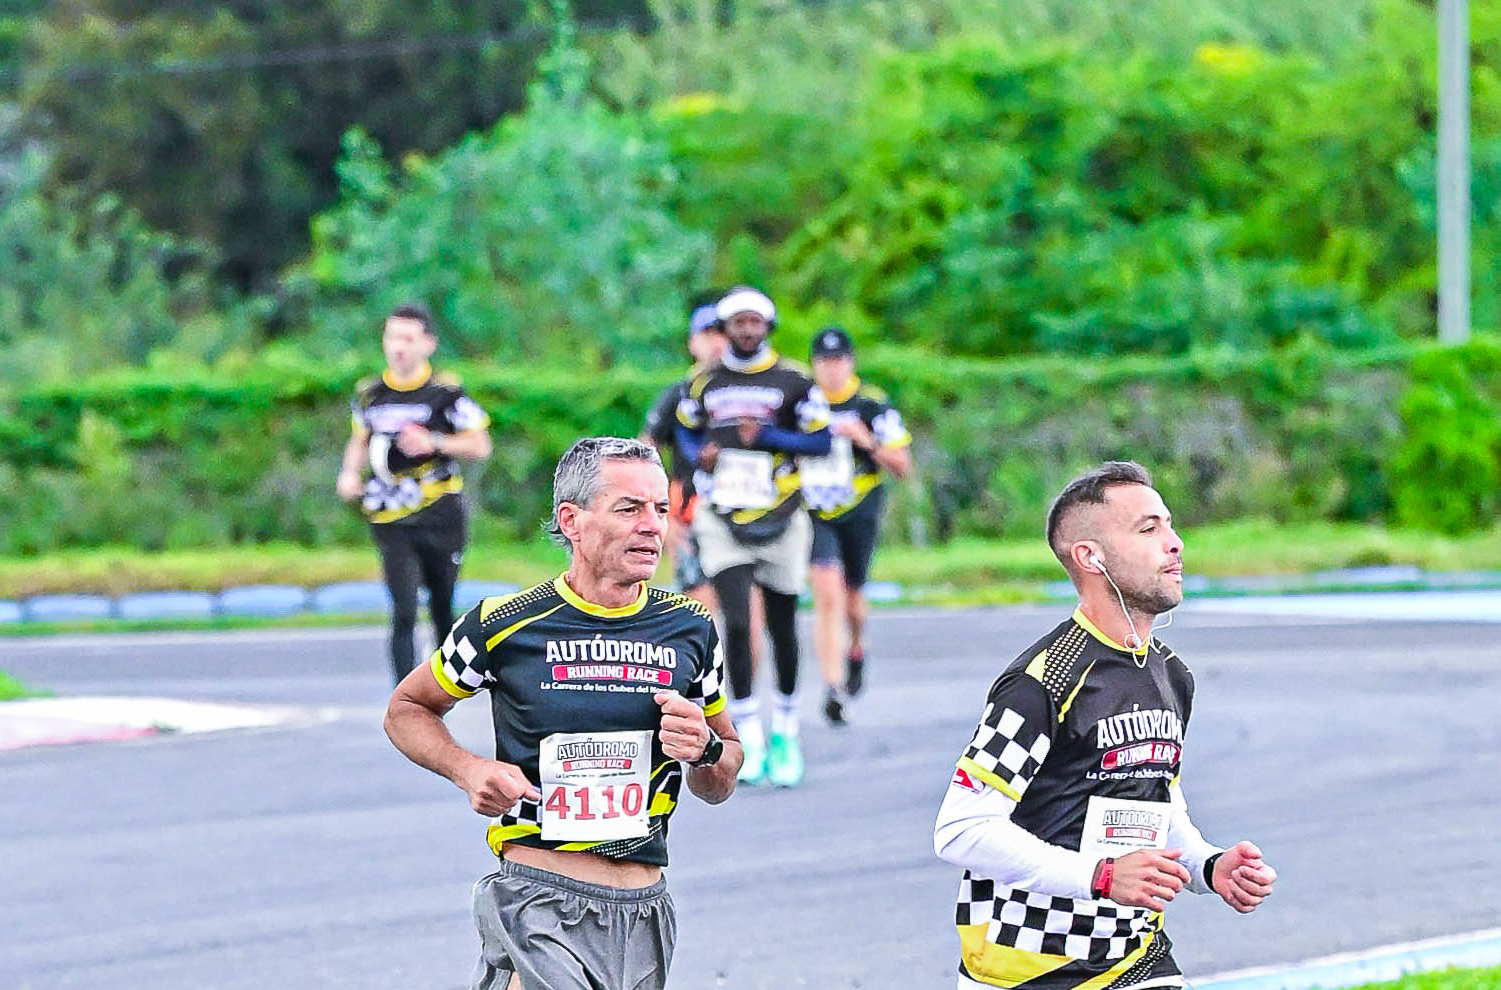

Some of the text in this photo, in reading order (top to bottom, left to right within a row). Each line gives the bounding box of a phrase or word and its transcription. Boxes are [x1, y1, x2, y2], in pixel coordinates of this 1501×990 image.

[545, 633, 677, 669] AUTÓDROMO
[540, 682, 551, 690] La
[551, 682, 582, 691] Carrera
[583, 683, 594, 692] de
[595, 683, 607, 692] los
[608, 684, 635, 693] Clubes
[636, 685, 649, 694] del
[567, 665, 659, 682] RUNNING RACE
[1097, 703, 1183, 749] AUTÓDROM
[557, 737, 639, 760] AUTÓDROMO
[545, 783, 644, 820] 4110
